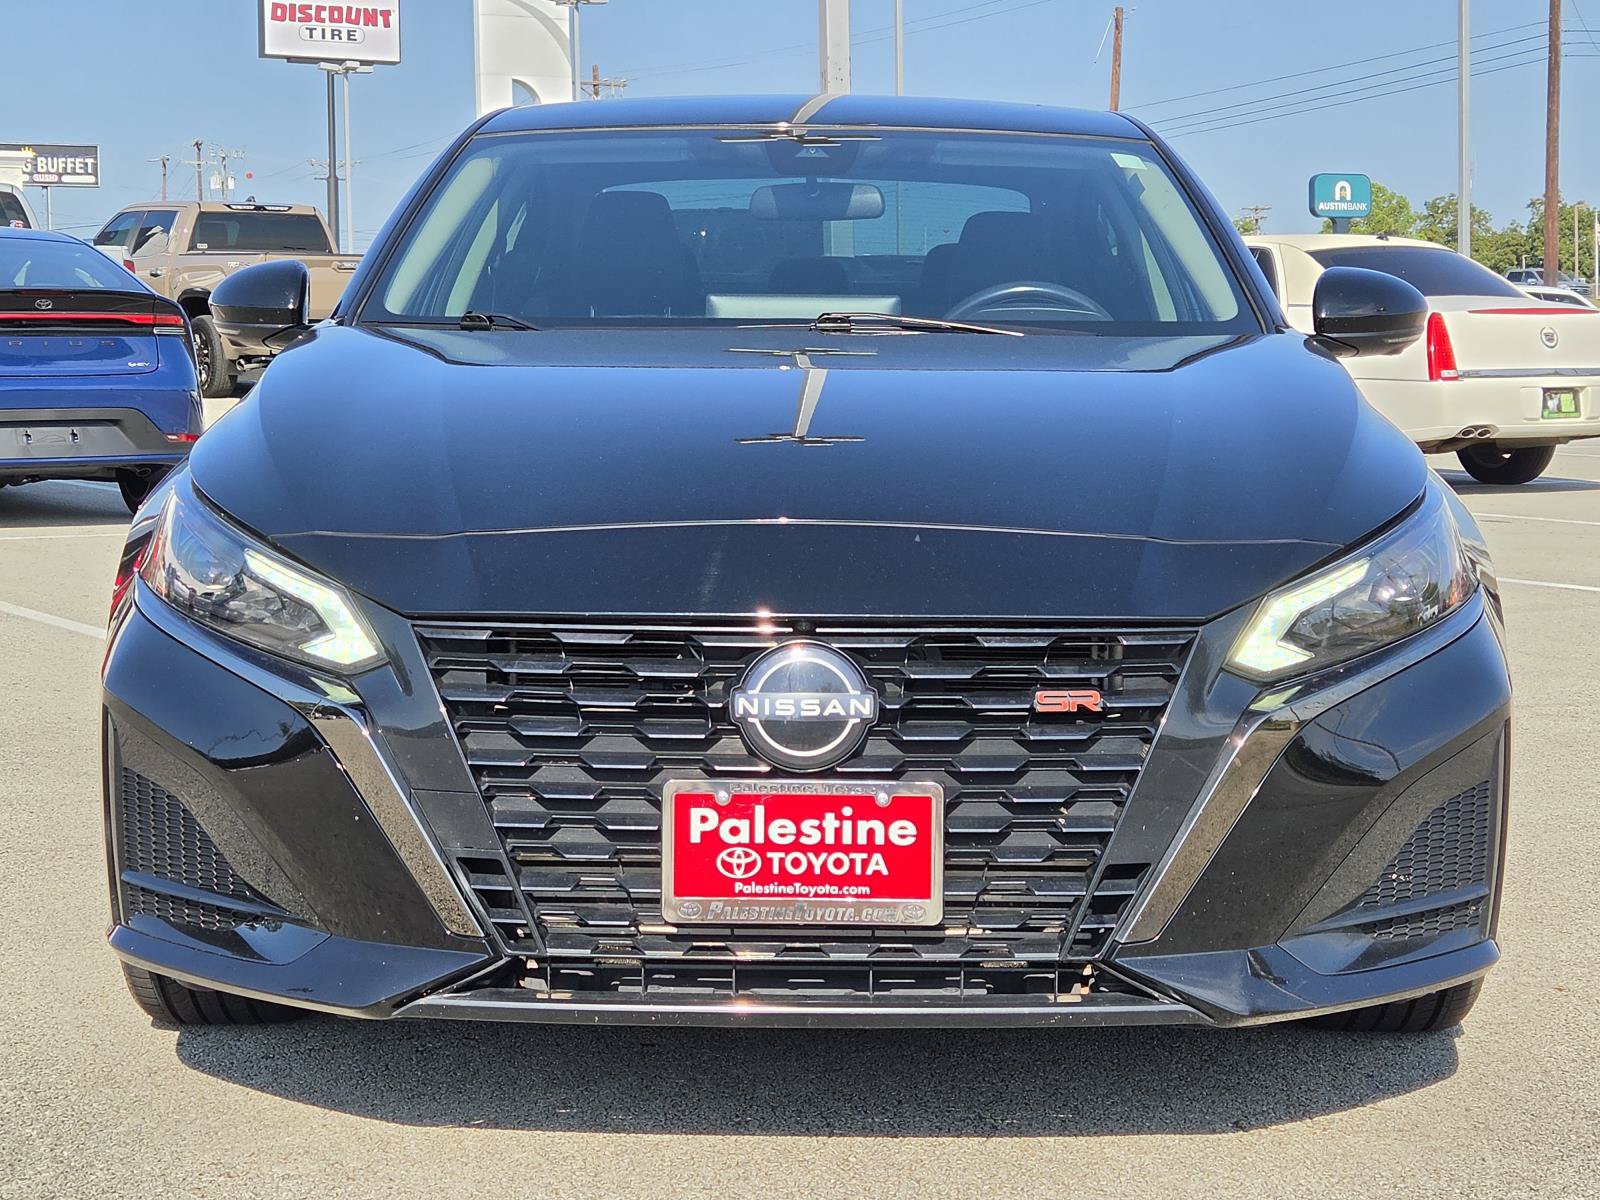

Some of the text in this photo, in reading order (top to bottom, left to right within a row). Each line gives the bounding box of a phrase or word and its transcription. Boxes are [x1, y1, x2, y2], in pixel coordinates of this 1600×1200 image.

[270, 2, 392, 28] DISCOUNT
[305, 27, 358, 41] TIRE
[37, 157, 95, 173] BUFFET
[738, 697, 870, 716] NISSAN
[1035, 690, 1102, 712] SR
[689, 804, 917, 846] Palestine
[766, 852, 889, 876] TOYOTA
[734, 882, 871, 897] PalestineToyota.com
